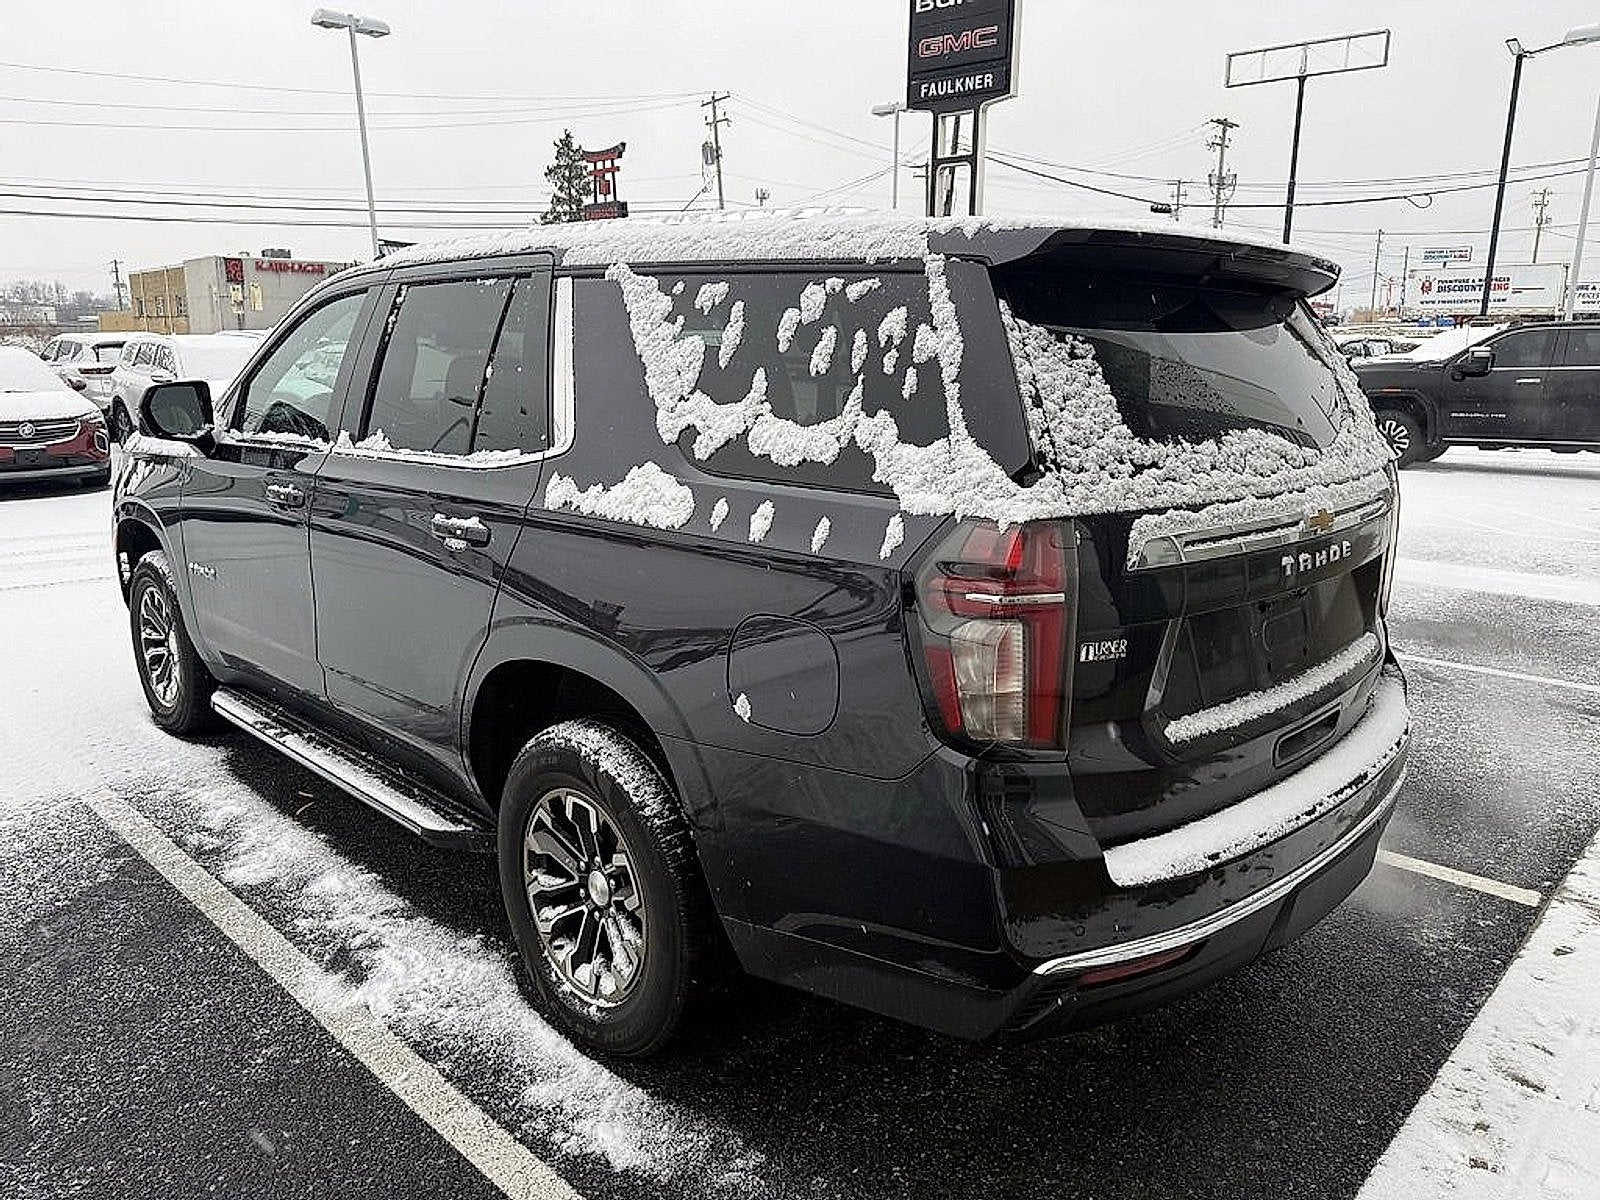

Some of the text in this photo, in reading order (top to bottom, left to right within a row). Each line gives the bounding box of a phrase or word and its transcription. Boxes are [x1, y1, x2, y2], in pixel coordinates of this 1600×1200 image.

[918, 25, 998, 58] GMC
[920, 73, 994, 98] FAULKNER
[1436, 283, 1483, 294] DISCOUNT
[1281, 540, 1352, 577] TAHOE
[1079, 639, 1128, 663] TURNER
